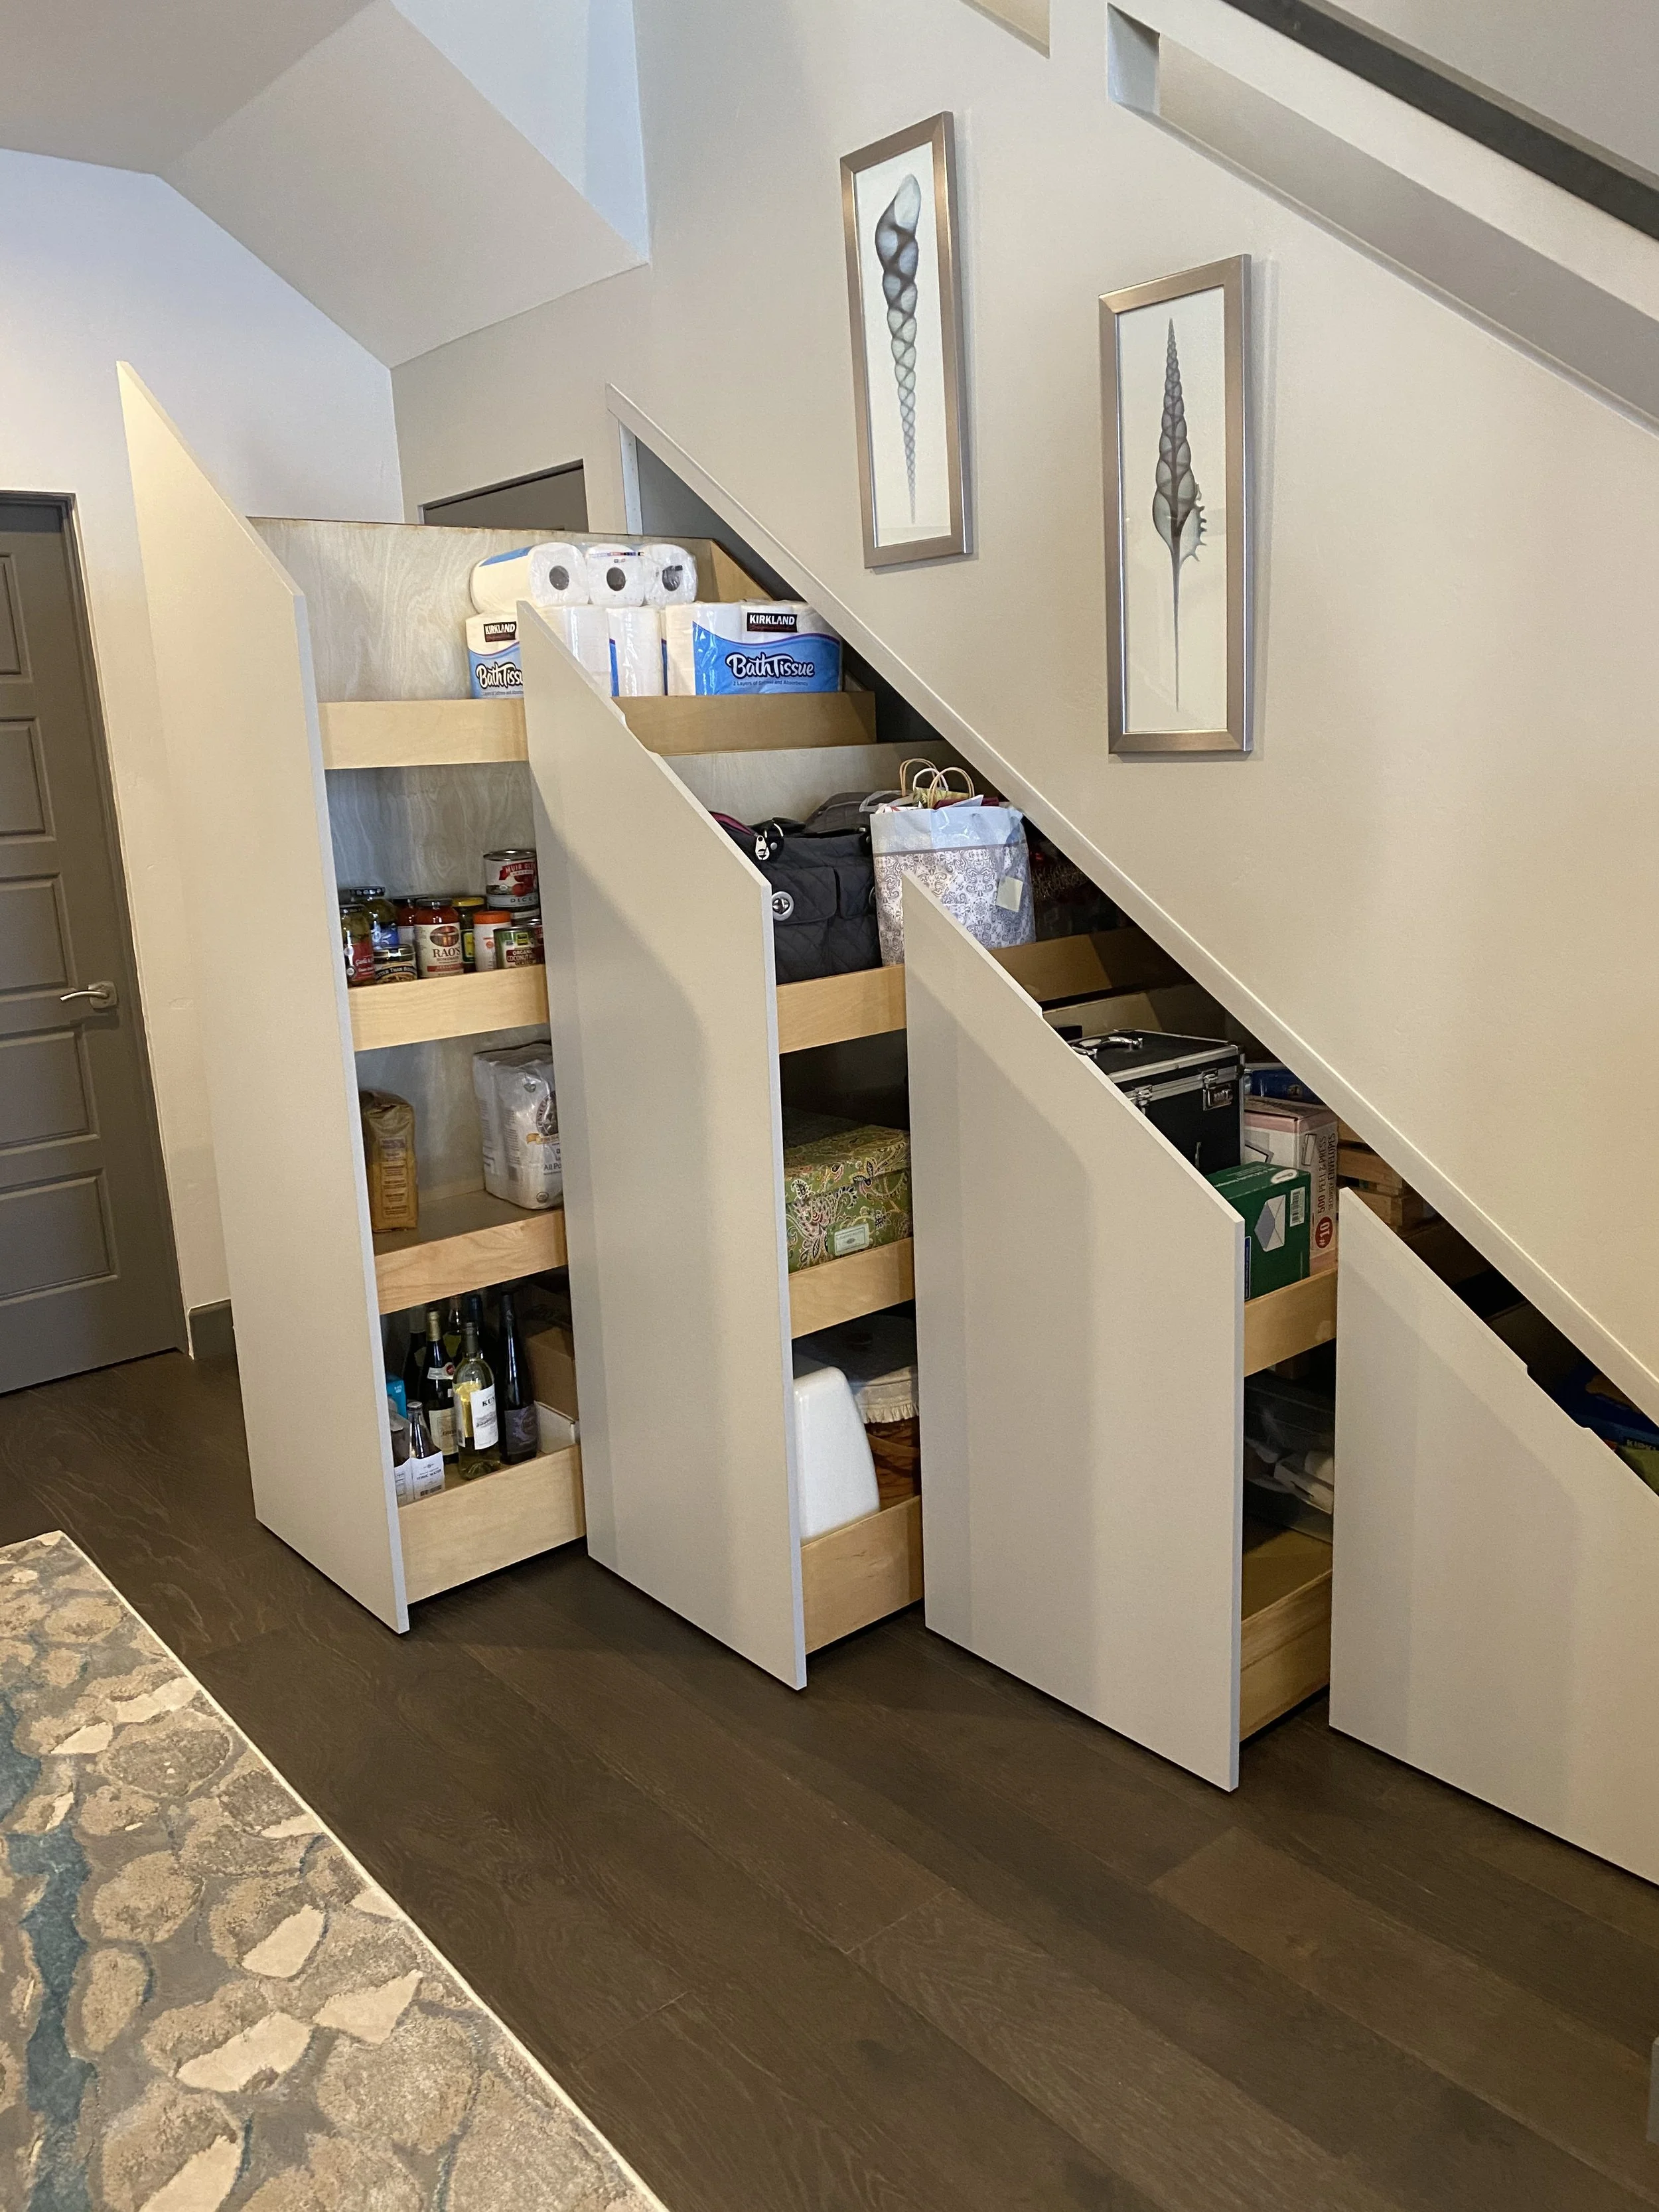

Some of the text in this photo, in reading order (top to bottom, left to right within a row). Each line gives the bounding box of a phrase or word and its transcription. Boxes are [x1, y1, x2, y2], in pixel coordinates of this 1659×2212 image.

[749, 615, 795, 625] KIRKLAND
[484, 624, 516, 634] KIRKLAND
[505, 863, 522, 873] MUIR
[1327, 1132, 1336, 1180] ENVELOPES
[1317, 1195, 1326, 1214] 500
